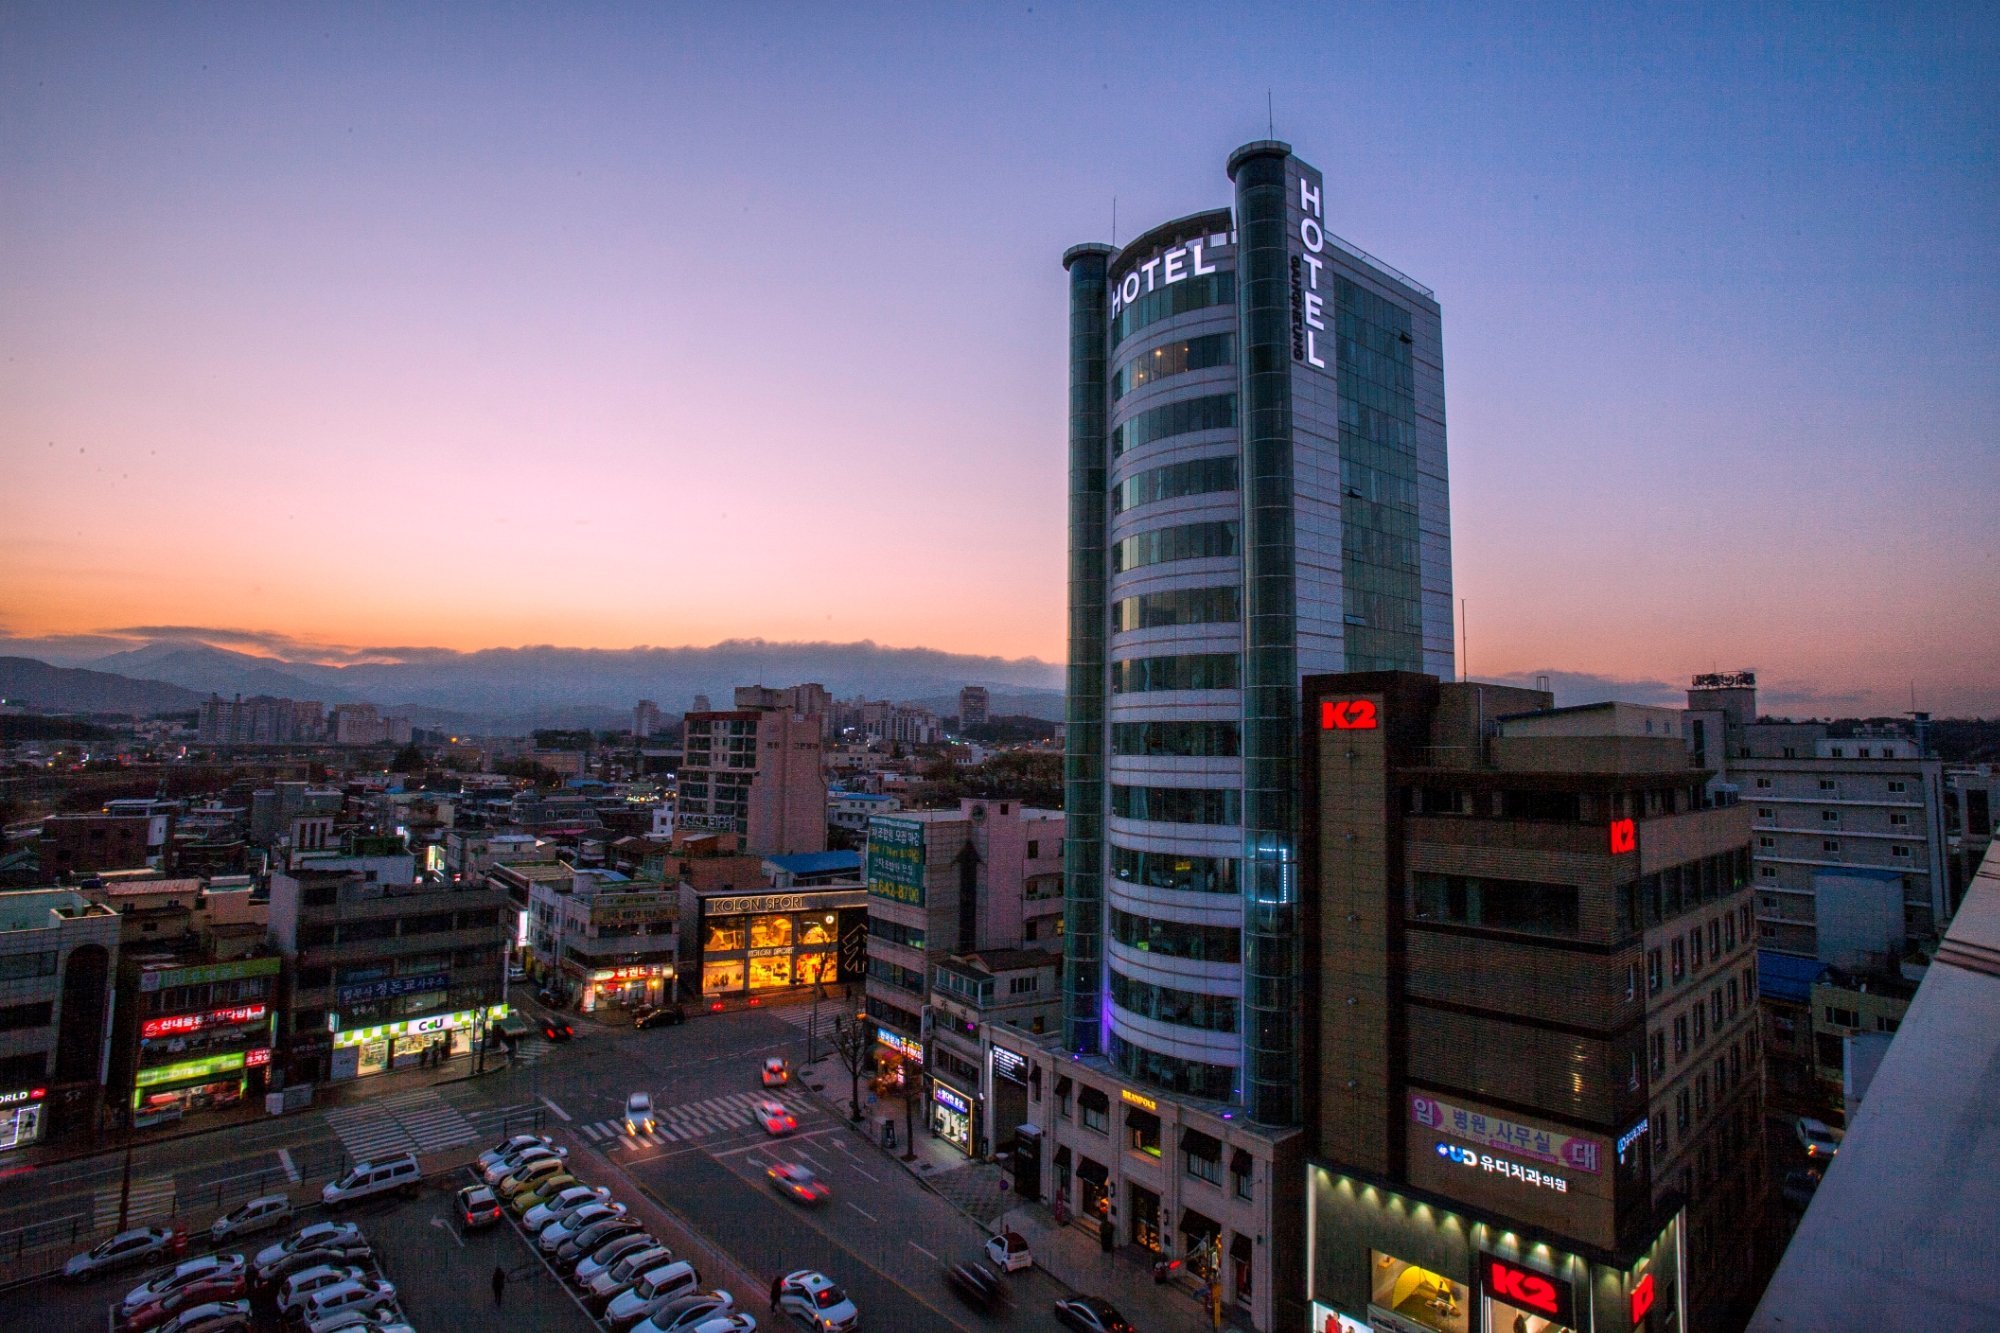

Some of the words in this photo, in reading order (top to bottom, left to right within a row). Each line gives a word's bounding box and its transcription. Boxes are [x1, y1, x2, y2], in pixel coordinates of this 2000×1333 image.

[1111, 244, 1216, 320] HOTEL
[1300, 177, 1325, 369] HOTEL
[1322, 699, 1377, 730] K2
[1610, 817, 1635, 855] K2
[713, 898, 761, 912] KOLON
[766, 895, 805, 910] SPORT
[418, 1018, 443, 1032] CU
[1413, 1098, 1435, 1127] 임
[1571, 1142, 1597, 1171] 대
[1479, 1155, 1569, 1193] 유디치과의원
[1491, 1263, 1558, 1314] K2
